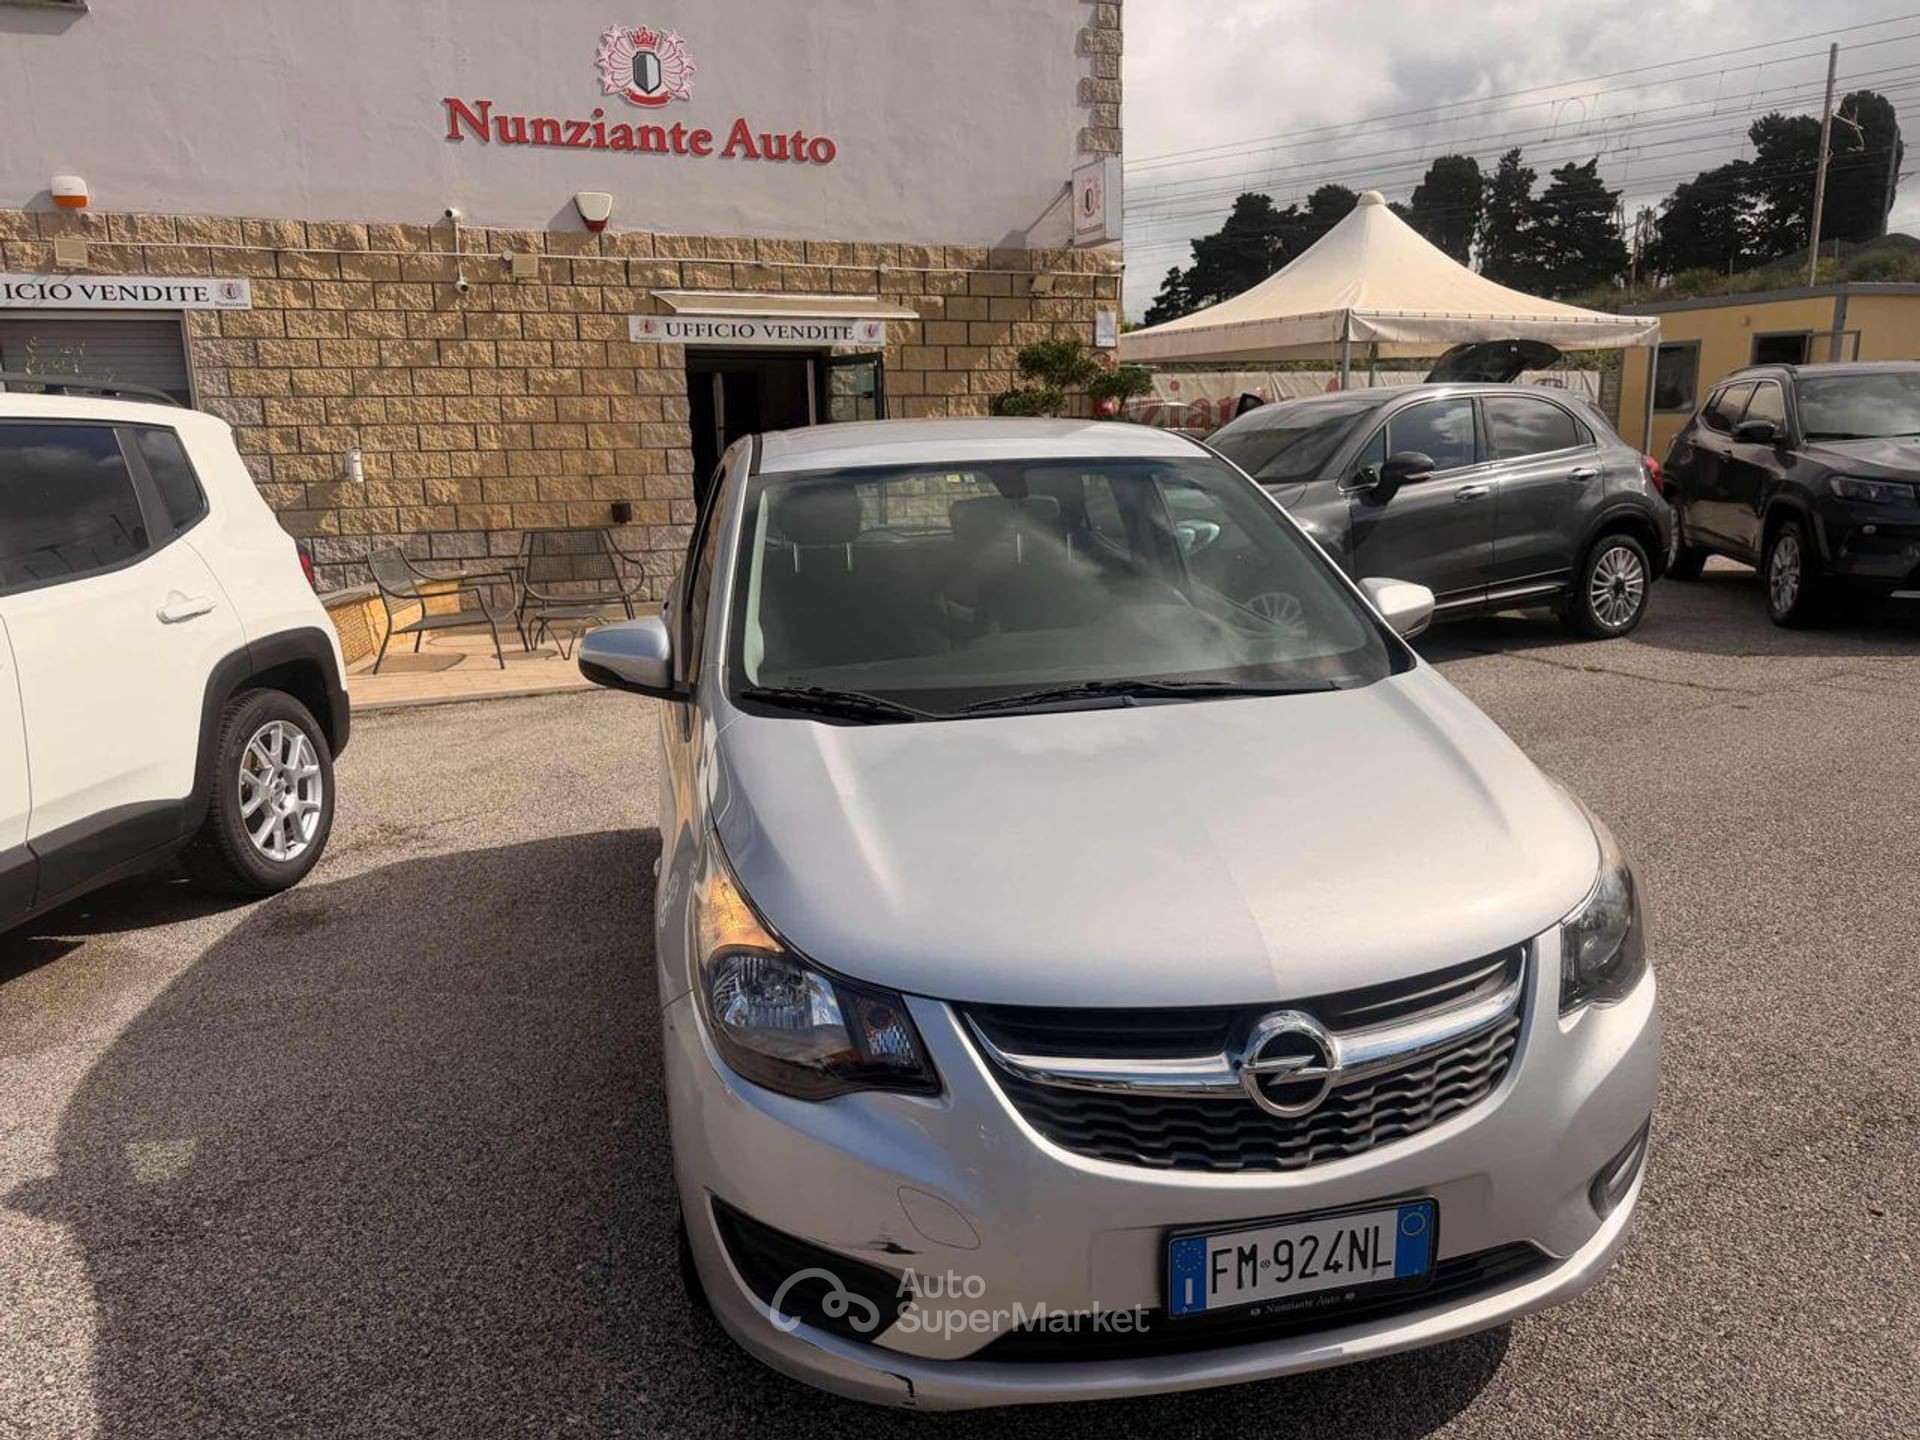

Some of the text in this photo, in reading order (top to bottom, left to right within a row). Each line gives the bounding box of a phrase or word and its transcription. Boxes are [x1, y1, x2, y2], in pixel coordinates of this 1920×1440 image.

[443, 97, 838, 164] Nunziante Auto
[4, 283, 210, 303] ICIO VENDITE
[665, 322, 854, 341] UFFICIO VENDITE
